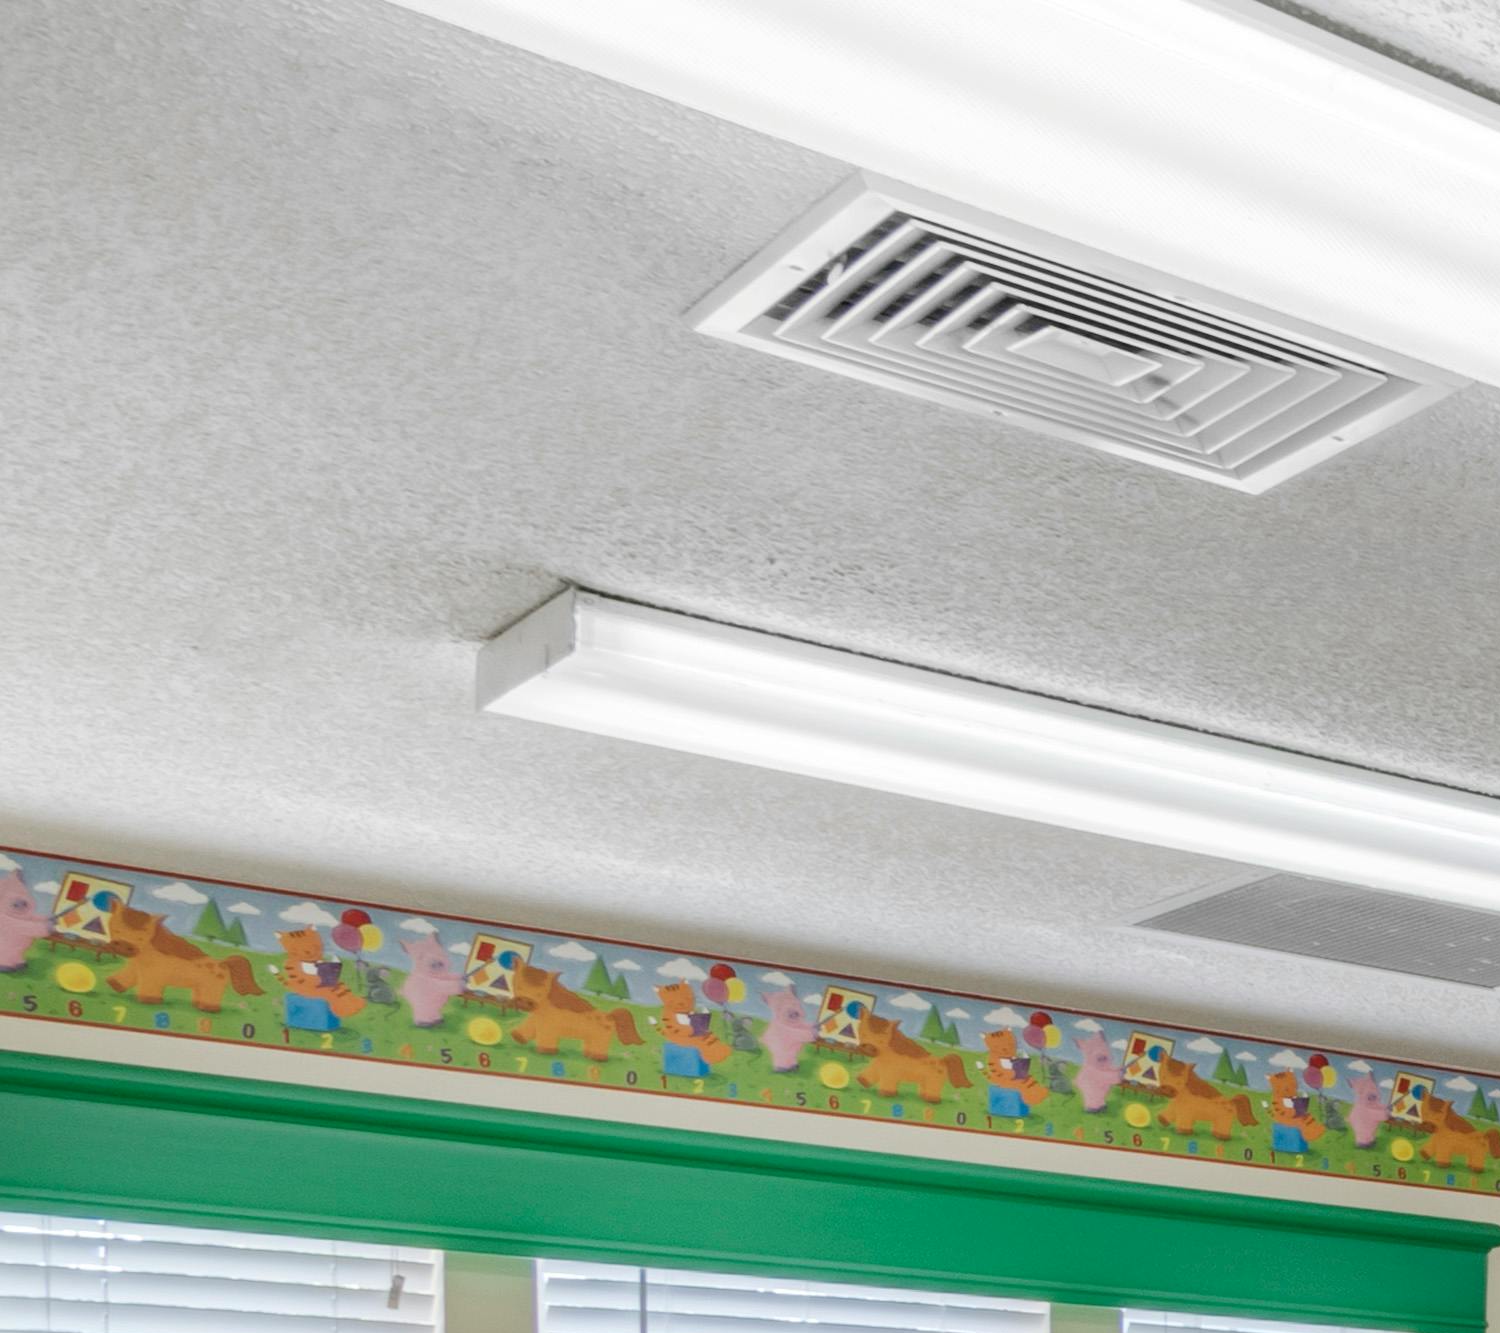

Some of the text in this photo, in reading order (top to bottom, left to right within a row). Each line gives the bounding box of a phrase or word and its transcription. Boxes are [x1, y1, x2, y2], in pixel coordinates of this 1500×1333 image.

[23, 995, 37, 1011] 5
[68, 1000, 83, 1017] 6
[112, 1006, 127, 1023] 7
[242, 1023, 255, 1039] 0
[440, 1048, 452, 1064] 5
[626, 1071, 637, 1085] 0
[796, 1092, 806, 1106] 5
